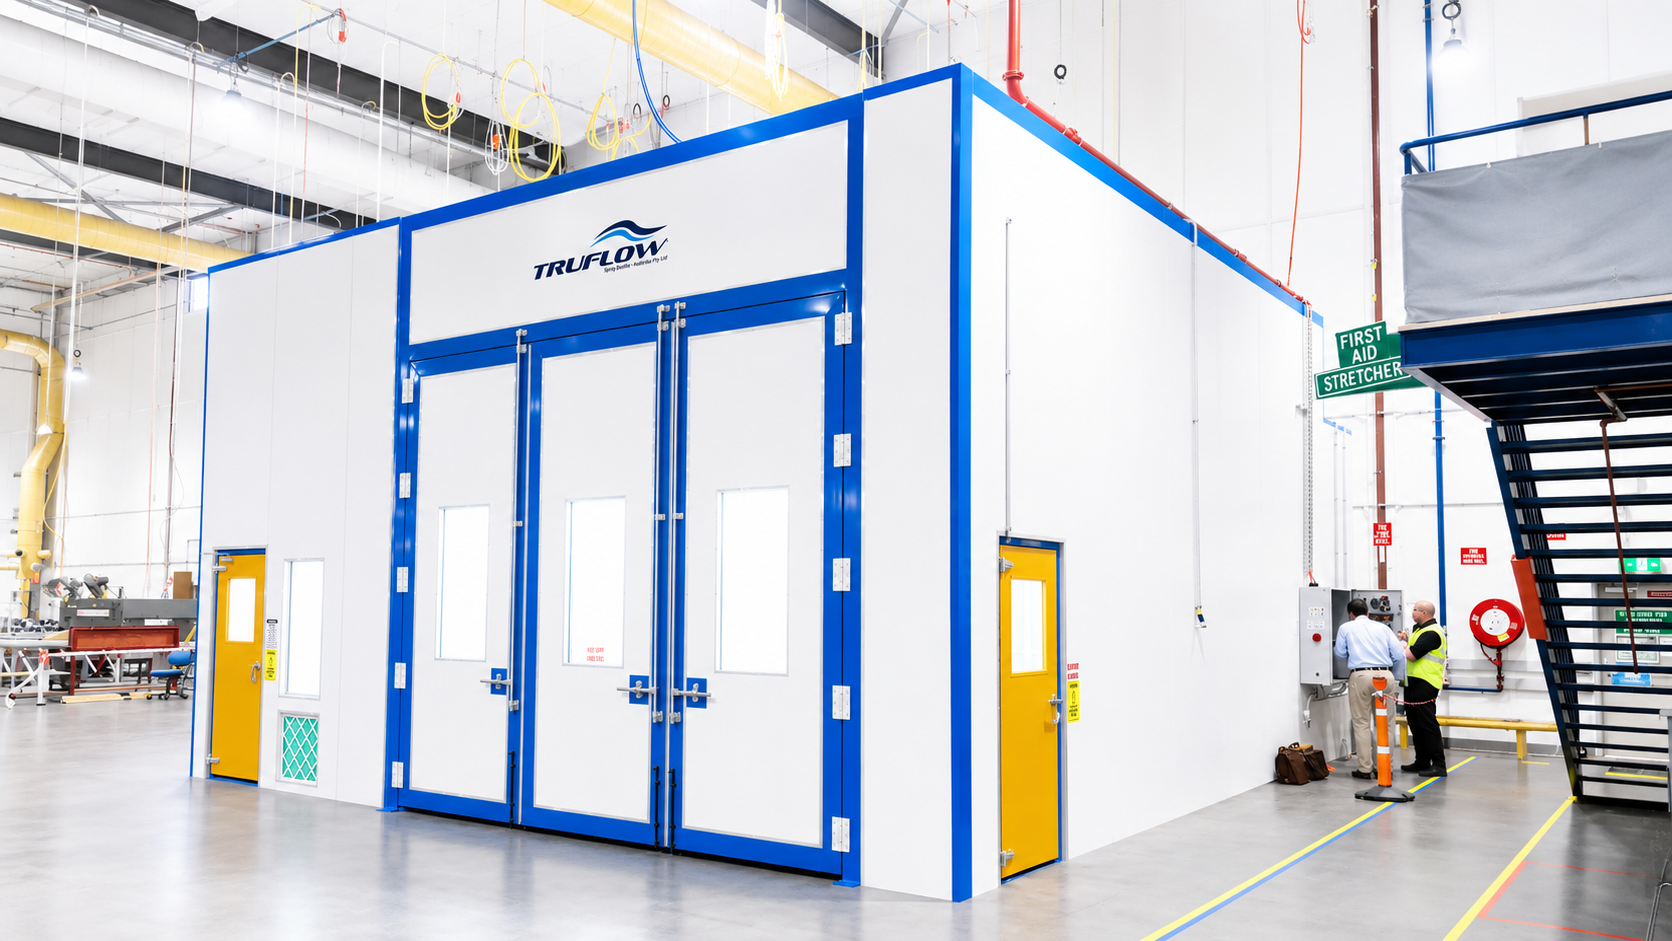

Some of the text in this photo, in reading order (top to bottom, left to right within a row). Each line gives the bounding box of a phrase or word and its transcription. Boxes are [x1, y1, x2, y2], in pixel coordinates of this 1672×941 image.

[533, 237, 668, 280] TRUFLOW
[1340, 326, 1382, 349] FIRST
[1352, 345, 1377, 365] AID
[1324, 362, 1402, 391] STRETCHER
